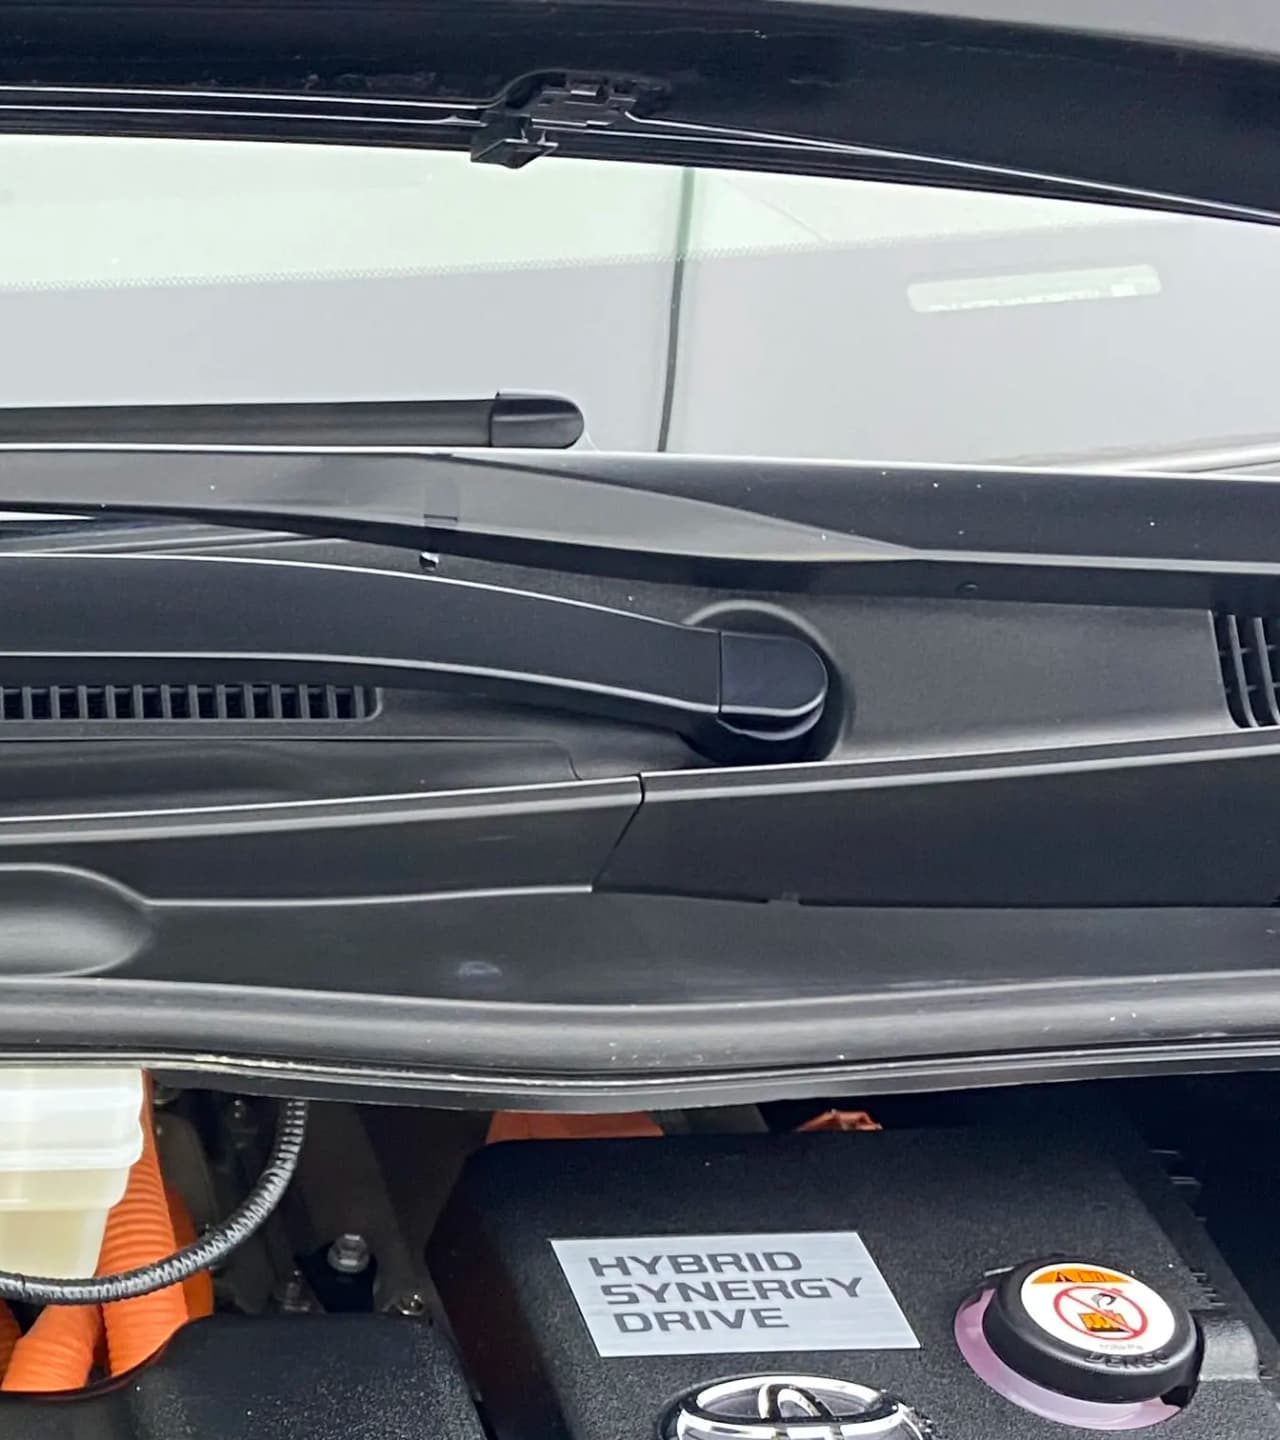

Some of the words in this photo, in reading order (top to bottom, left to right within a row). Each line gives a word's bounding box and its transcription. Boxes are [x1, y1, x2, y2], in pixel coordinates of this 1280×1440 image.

[588, 1251, 802, 1277] HYBRID
[600, 1277, 862, 1305] SYNERGY
[613, 1308, 789, 1333] DRIVE
